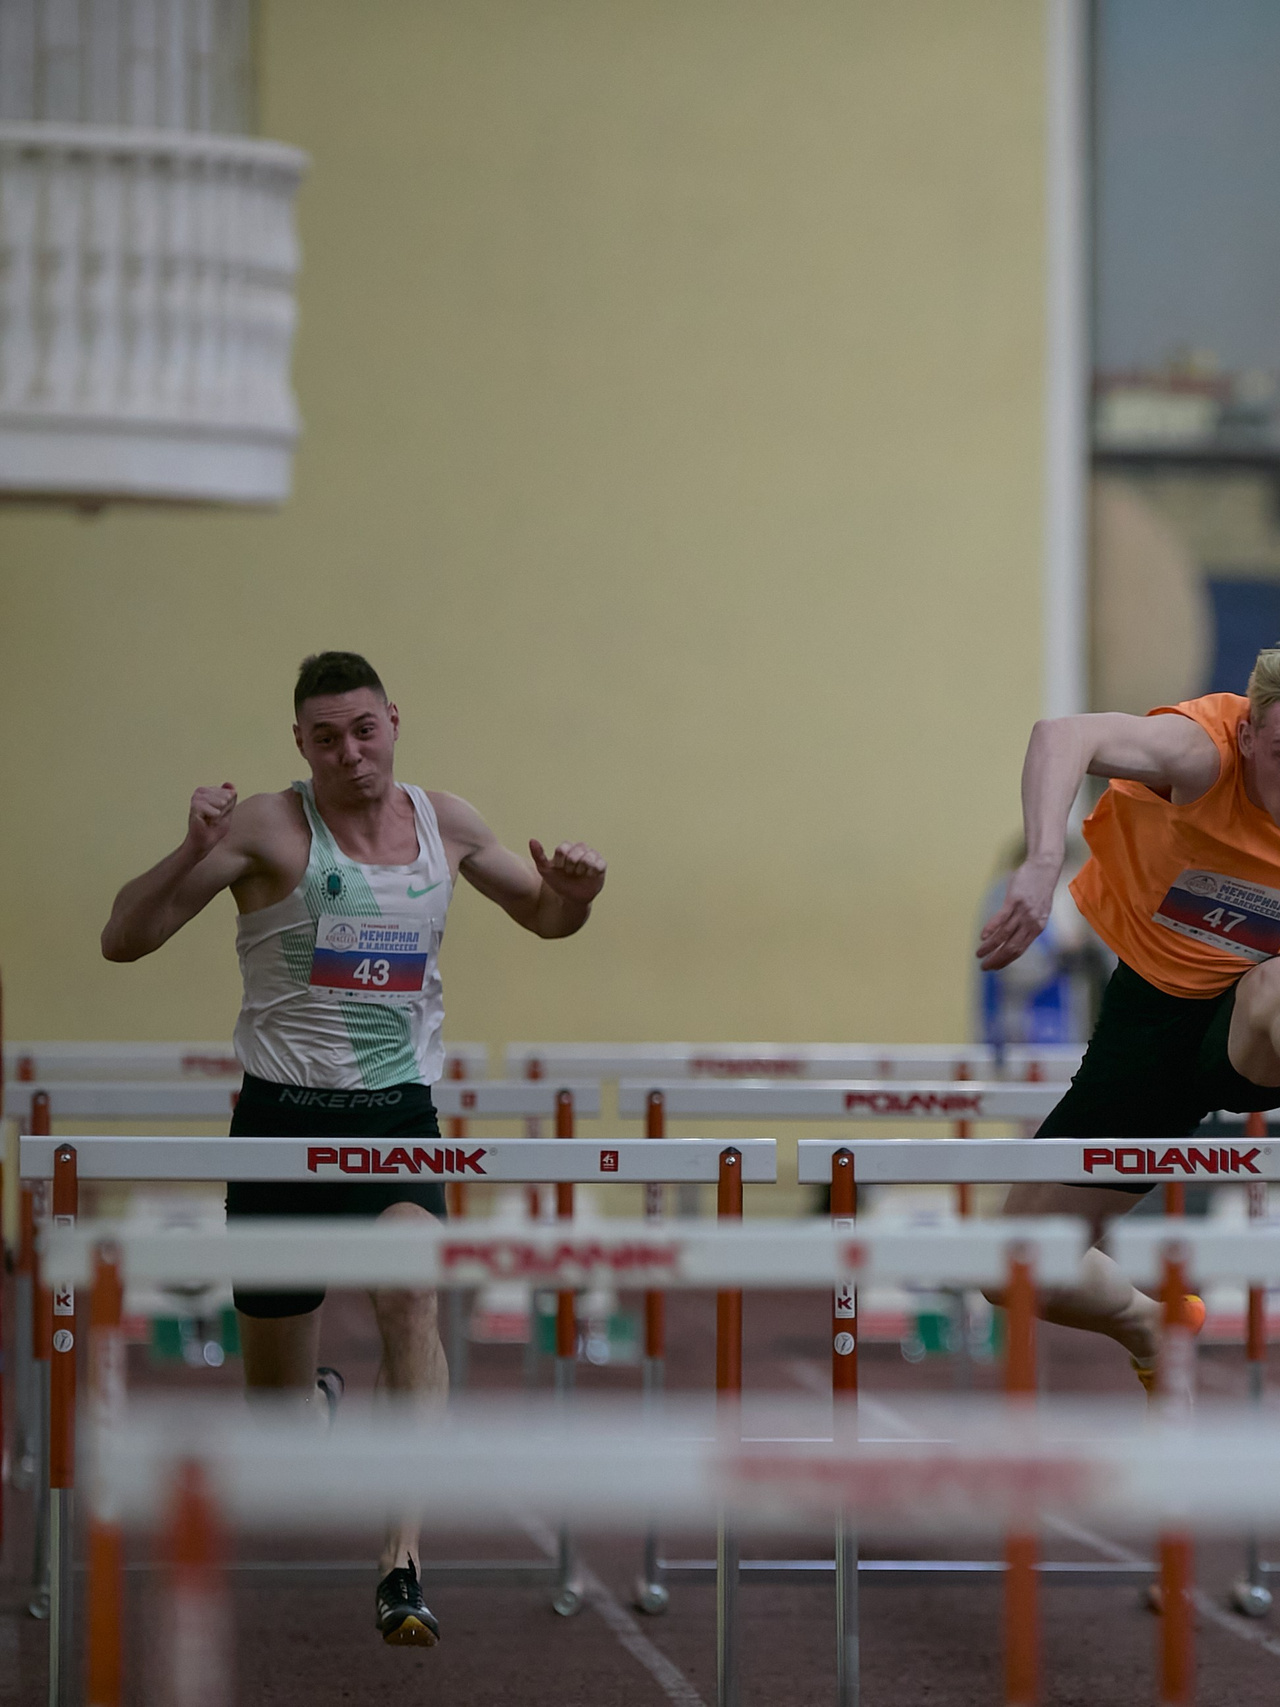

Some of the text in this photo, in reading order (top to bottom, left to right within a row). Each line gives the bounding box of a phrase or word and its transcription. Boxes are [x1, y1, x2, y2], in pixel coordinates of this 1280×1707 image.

[1202, 907, 1248, 933] 47
[359, 929, 420, 942] МЕМОРИАЛ
[353, 958, 390, 986] 43
[279, 1088, 403, 1108] NIKE PRO
[308, 1147, 487, 1175] POLANIK
[1083, 1148, 1262, 1175] POLANIK
